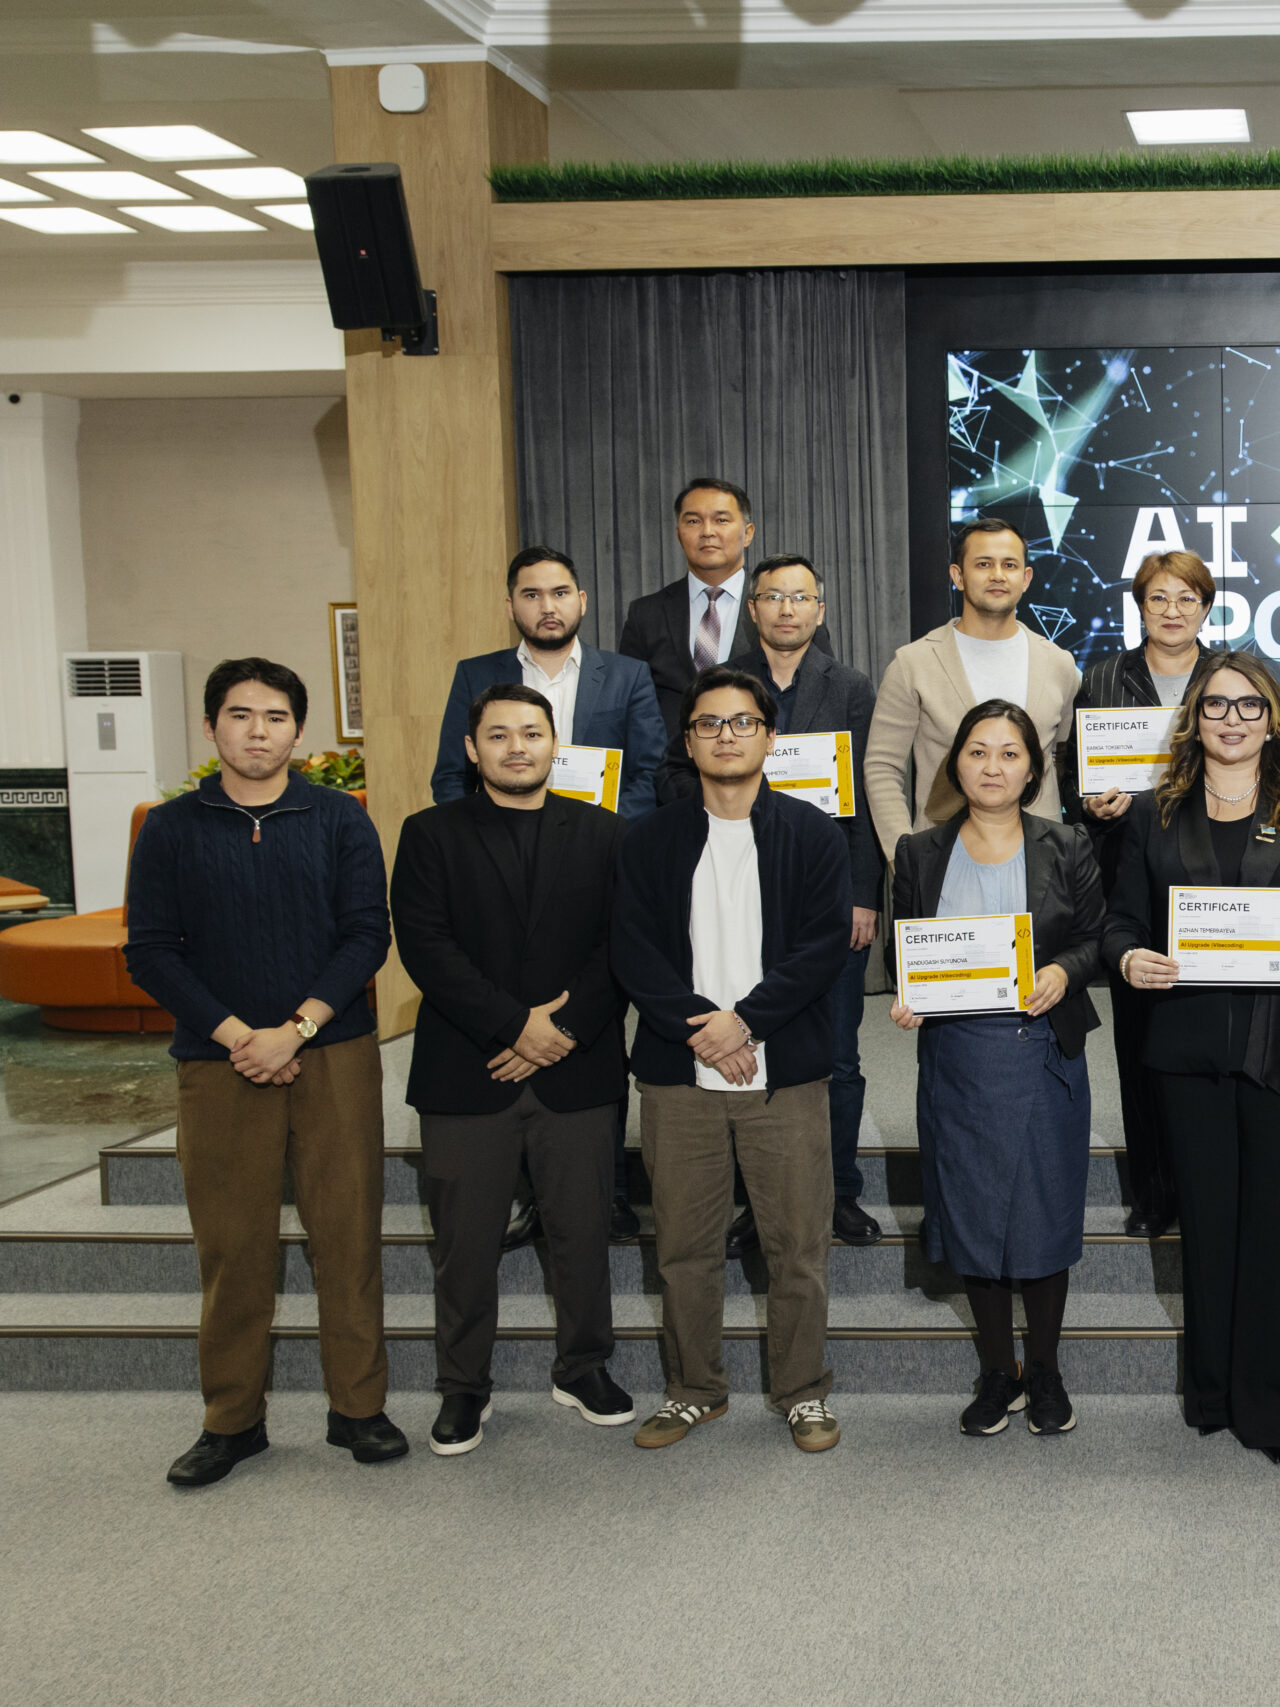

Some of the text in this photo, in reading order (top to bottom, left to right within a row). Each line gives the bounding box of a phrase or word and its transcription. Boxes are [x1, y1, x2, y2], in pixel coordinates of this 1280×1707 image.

[1121, 506, 1248, 579] AI
[1086, 722, 1148, 731] CERTIFICATE
[1179, 902, 1250, 912] CERTIFICATE
[905, 932, 975, 944] CERTIFICATE
